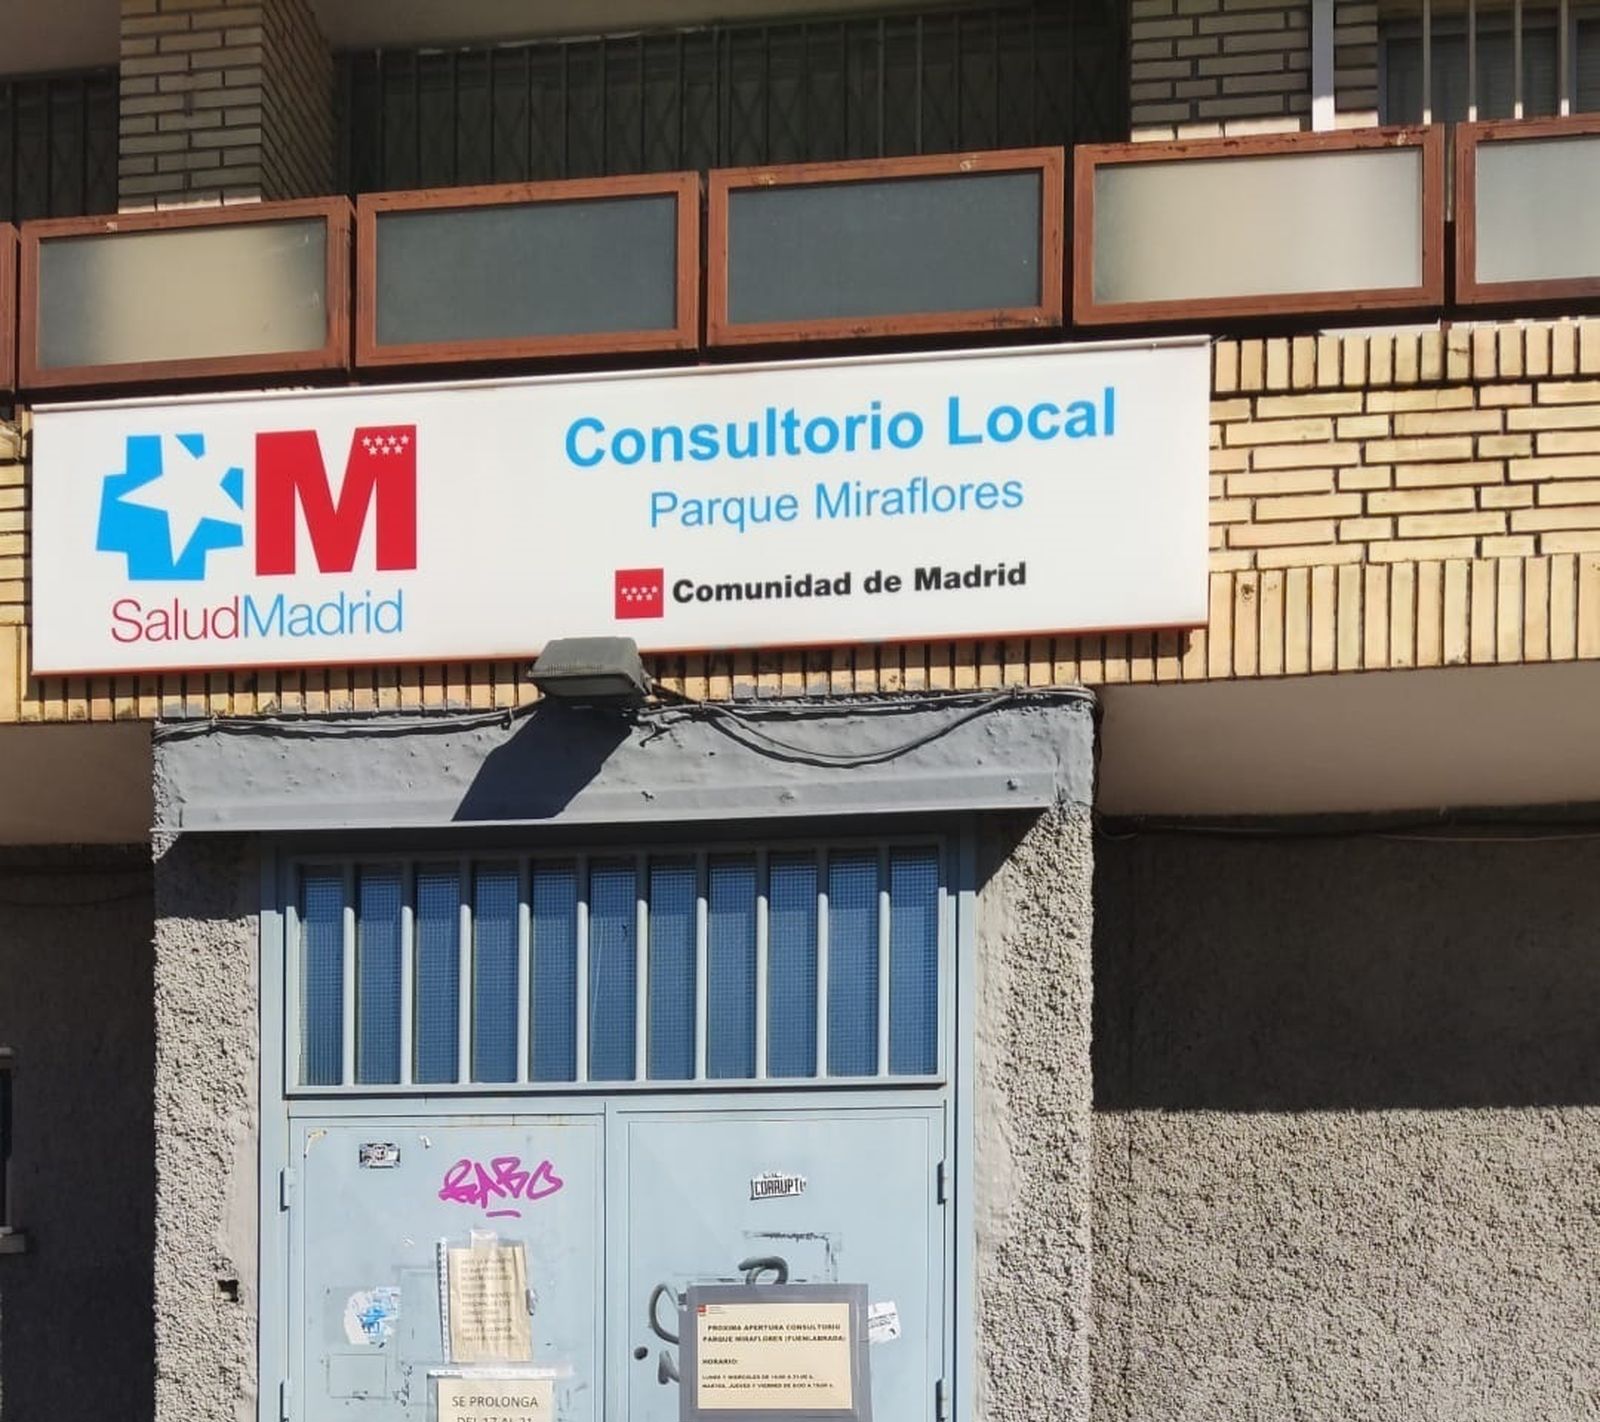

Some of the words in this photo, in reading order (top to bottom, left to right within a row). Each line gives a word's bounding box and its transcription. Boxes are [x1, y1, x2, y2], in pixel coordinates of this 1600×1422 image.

[565, 401, 924, 467] Consultorio
[948, 387, 1115, 445] Local
[650, 488, 799, 534] Parque
[816, 475, 1024, 520] Miraflores
[672, 573, 850, 604] Comunidad
[862, 568, 902, 595] de
[914, 562, 1027, 591] Madrid
[111, 589, 403, 643] SaludMadrid
[452, 1396, 466, 1407] SE
[469, 1396, 538, 1408] PROLONGA
